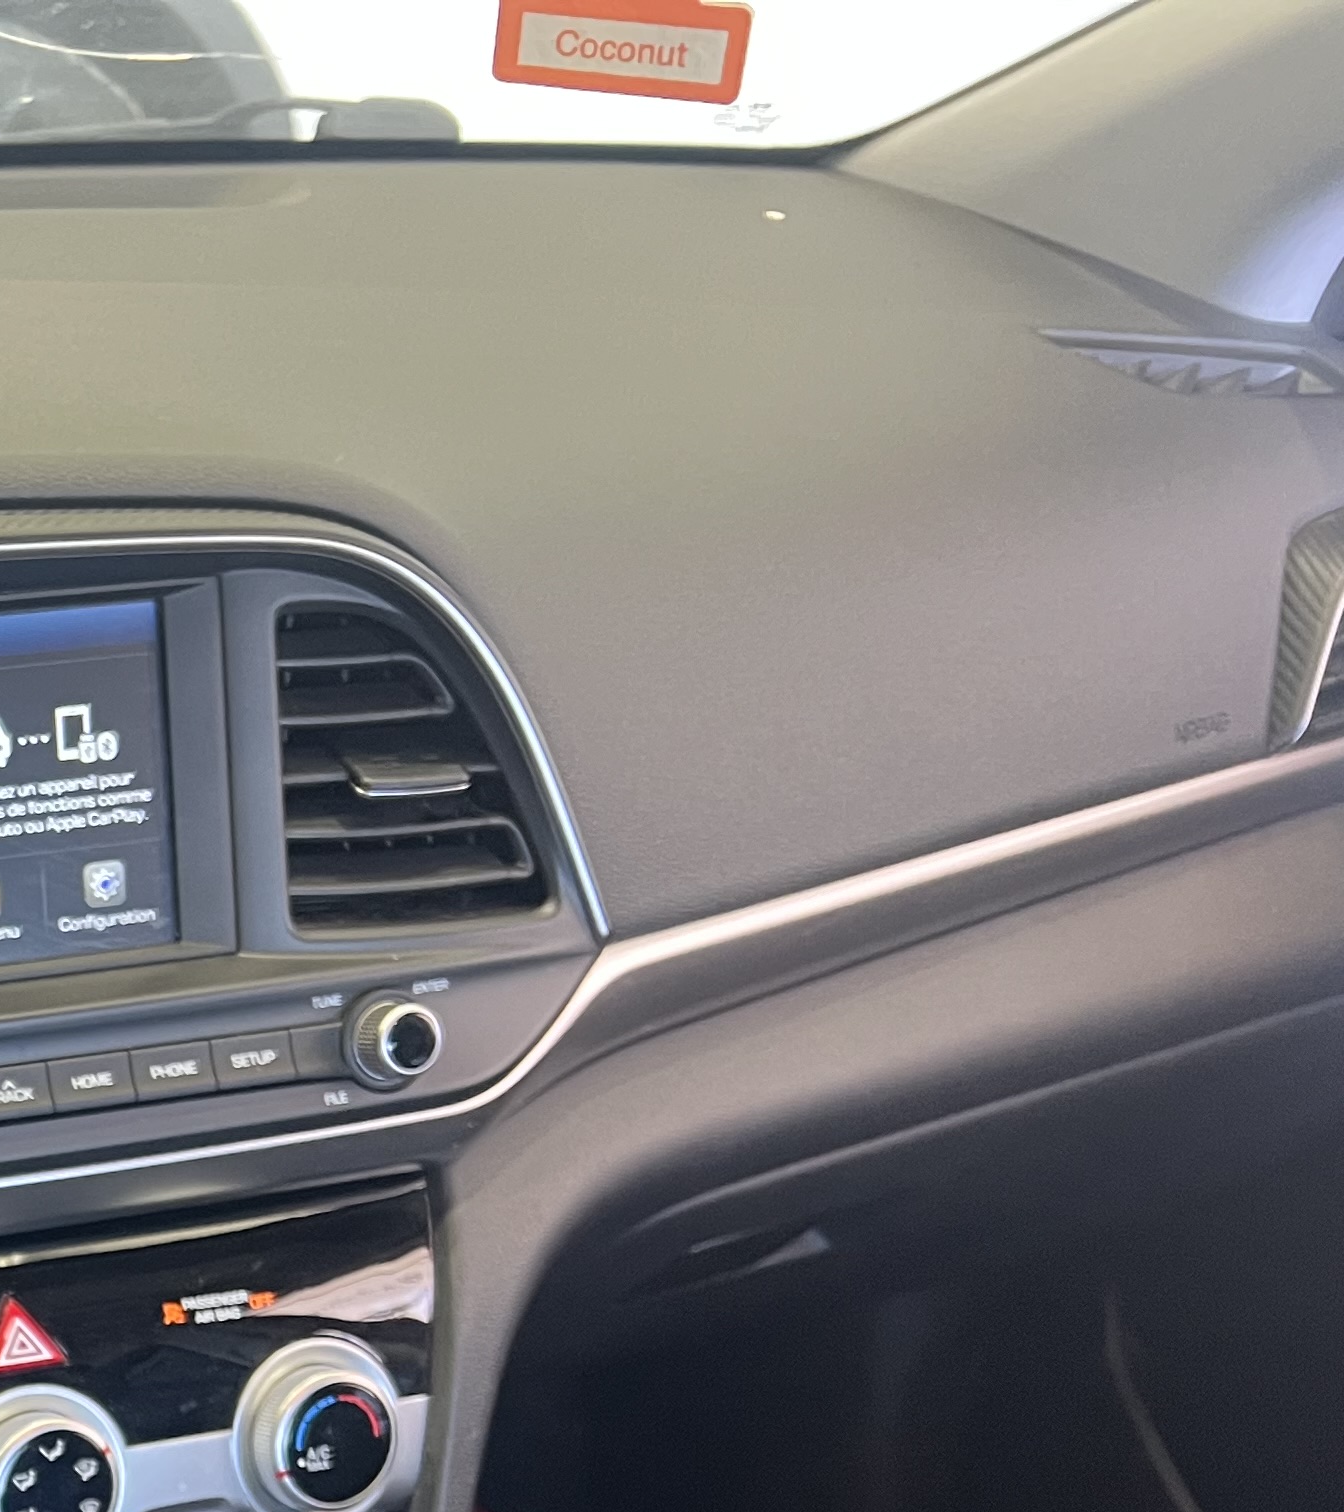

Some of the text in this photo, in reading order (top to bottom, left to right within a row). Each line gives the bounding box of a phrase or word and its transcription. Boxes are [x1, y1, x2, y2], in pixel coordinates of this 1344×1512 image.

[555, 29, 689, 68] Coconut
[17, 783, 36, 798] un
[37, 774, 98, 796] appareil
[99, 773, 135, 791] pour
[6, 802, 26, 817] de
[27, 796, 96, 815] fonctions
[97, 789, 153, 807] comme
[24, 820, 44, 834] ou
[45, 814, 86, 833] Apple
[58, 908, 158, 932] Configuration
[149, 1059, 199, 1080] PHONE
[230, 1048, 278, 1069] SETUP
[70, 1071, 114, 1090] HOME
[180, 1288, 248, 1311] PASSENGER
